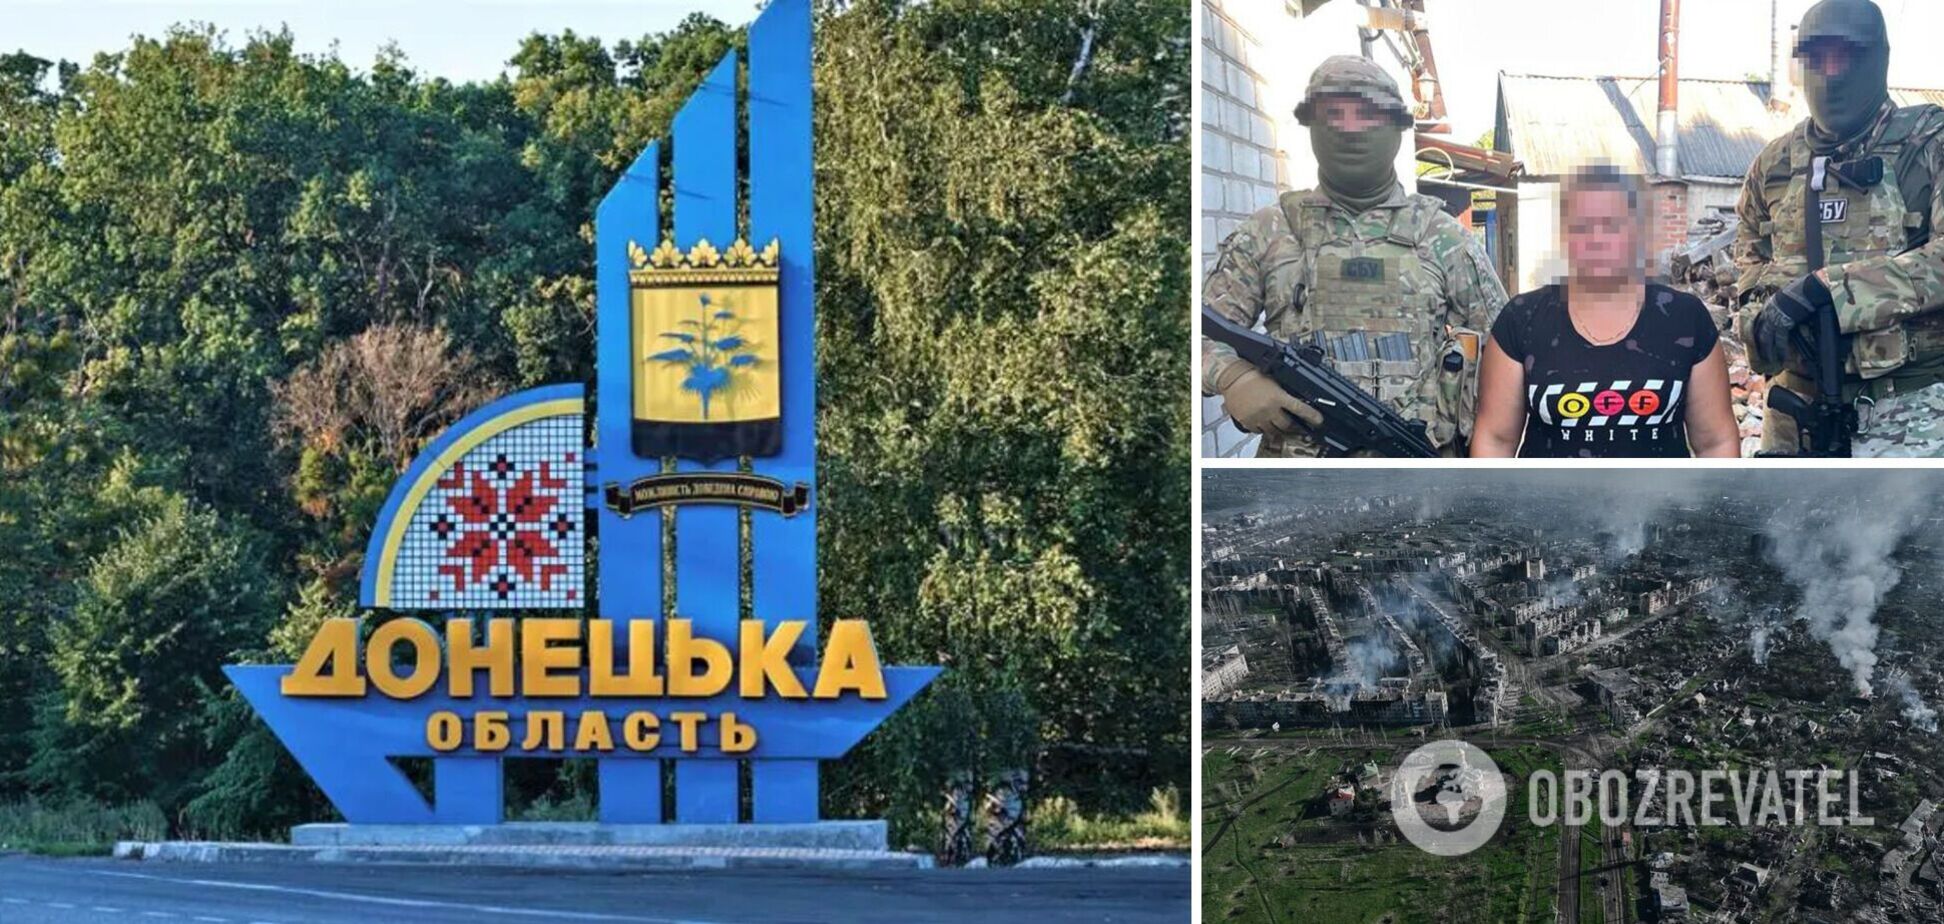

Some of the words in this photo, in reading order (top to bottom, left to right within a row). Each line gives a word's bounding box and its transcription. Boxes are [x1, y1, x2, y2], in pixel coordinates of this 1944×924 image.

[1347, 262, 1379, 277] СБУ
[1559, 389, 1657, 415] OFF
[1561, 428, 1659, 441] WHITE
[281, 618, 886, 699] ДОНЕЦЬКА
[426, 710, 758, 752] ОБЛАСТЬ
